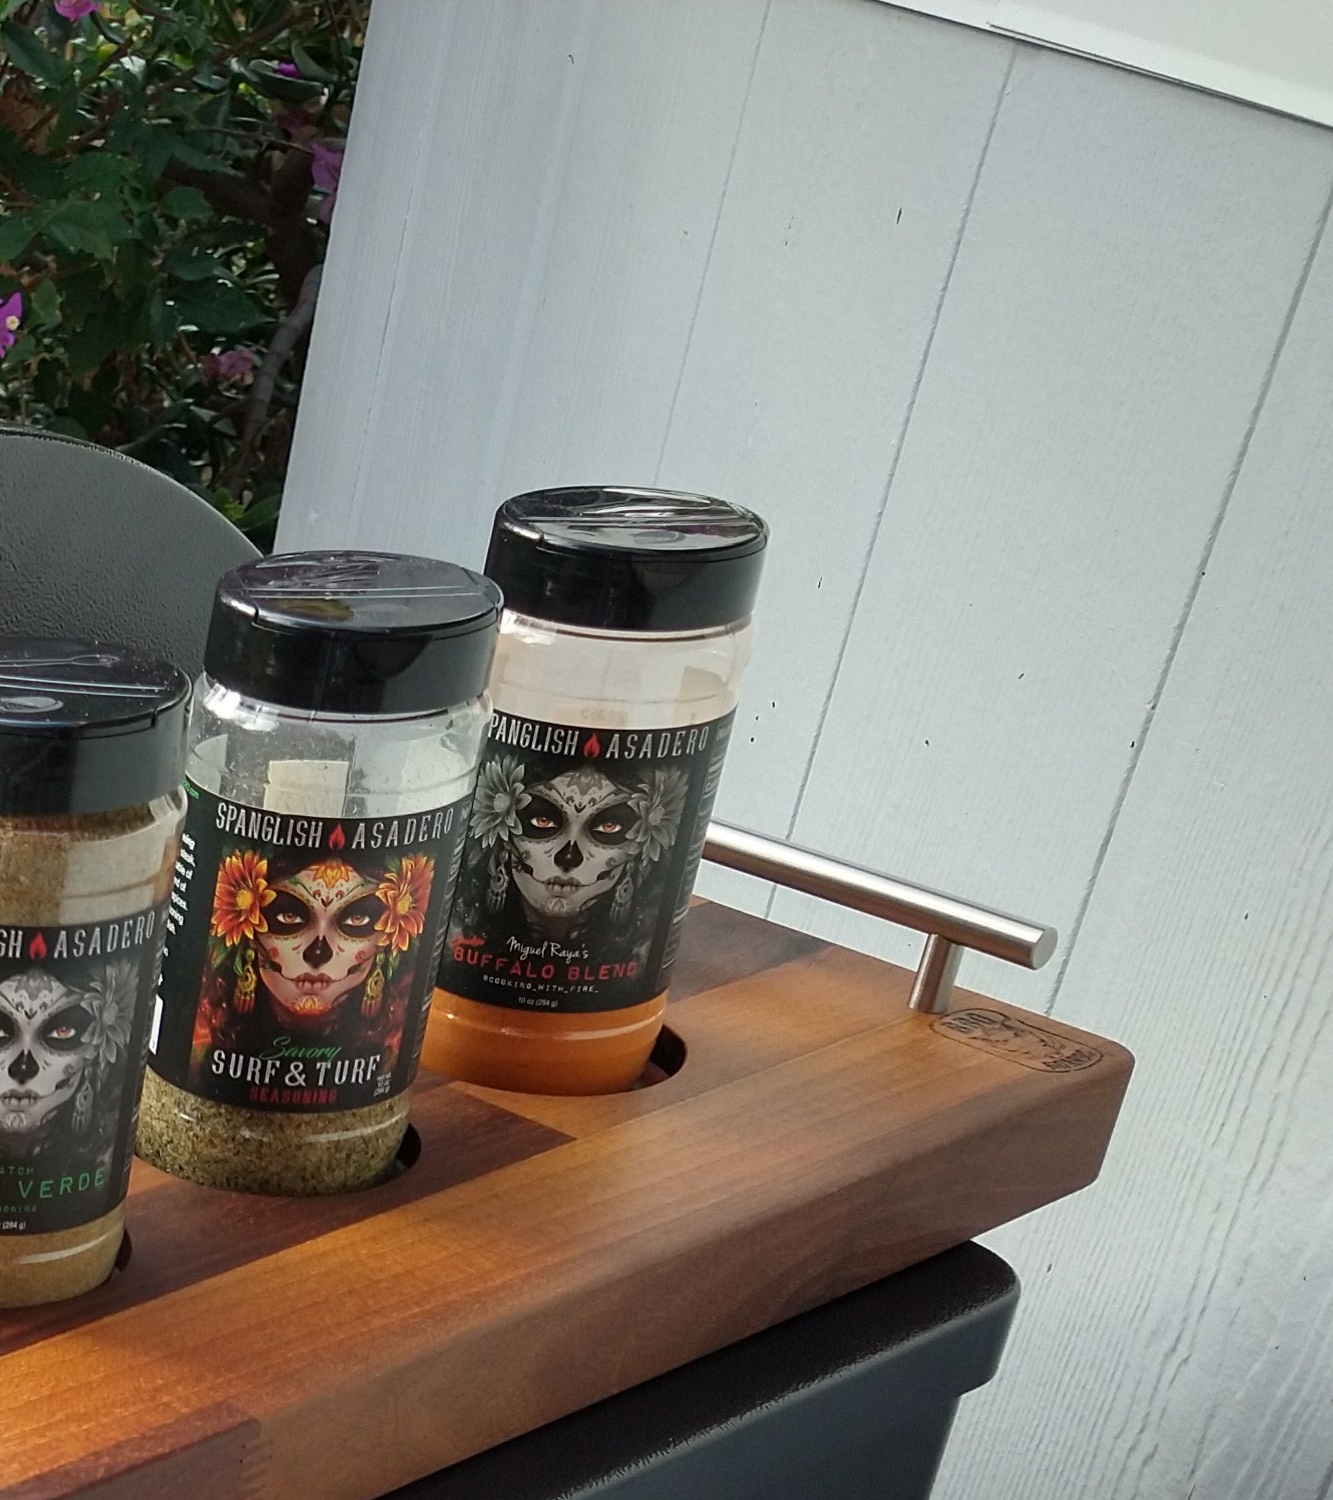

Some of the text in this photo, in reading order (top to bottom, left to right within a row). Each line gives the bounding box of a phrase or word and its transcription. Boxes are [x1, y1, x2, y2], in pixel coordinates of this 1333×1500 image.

[487, 713, 580, 757] PANGLISH
[605, 726, 710, 760] ASADERO
[215, 802, 324, 849] SPANGLISH
[351, 807, 454, 850] ASADERO
[53, 910, 156, 959] ASADERO
[506, 936, 548, 961] Miguel
[453, 946, 640, 981] BUFFALO BLEND
[259, 1036, 342, 1064] Savory
[211, 1050, 280, 1085] SURF
[284, 1061, 307, 1087] &
[316, 1054, 381, 1086] TURF
[18, 1167, 106, 1200] VERDE
